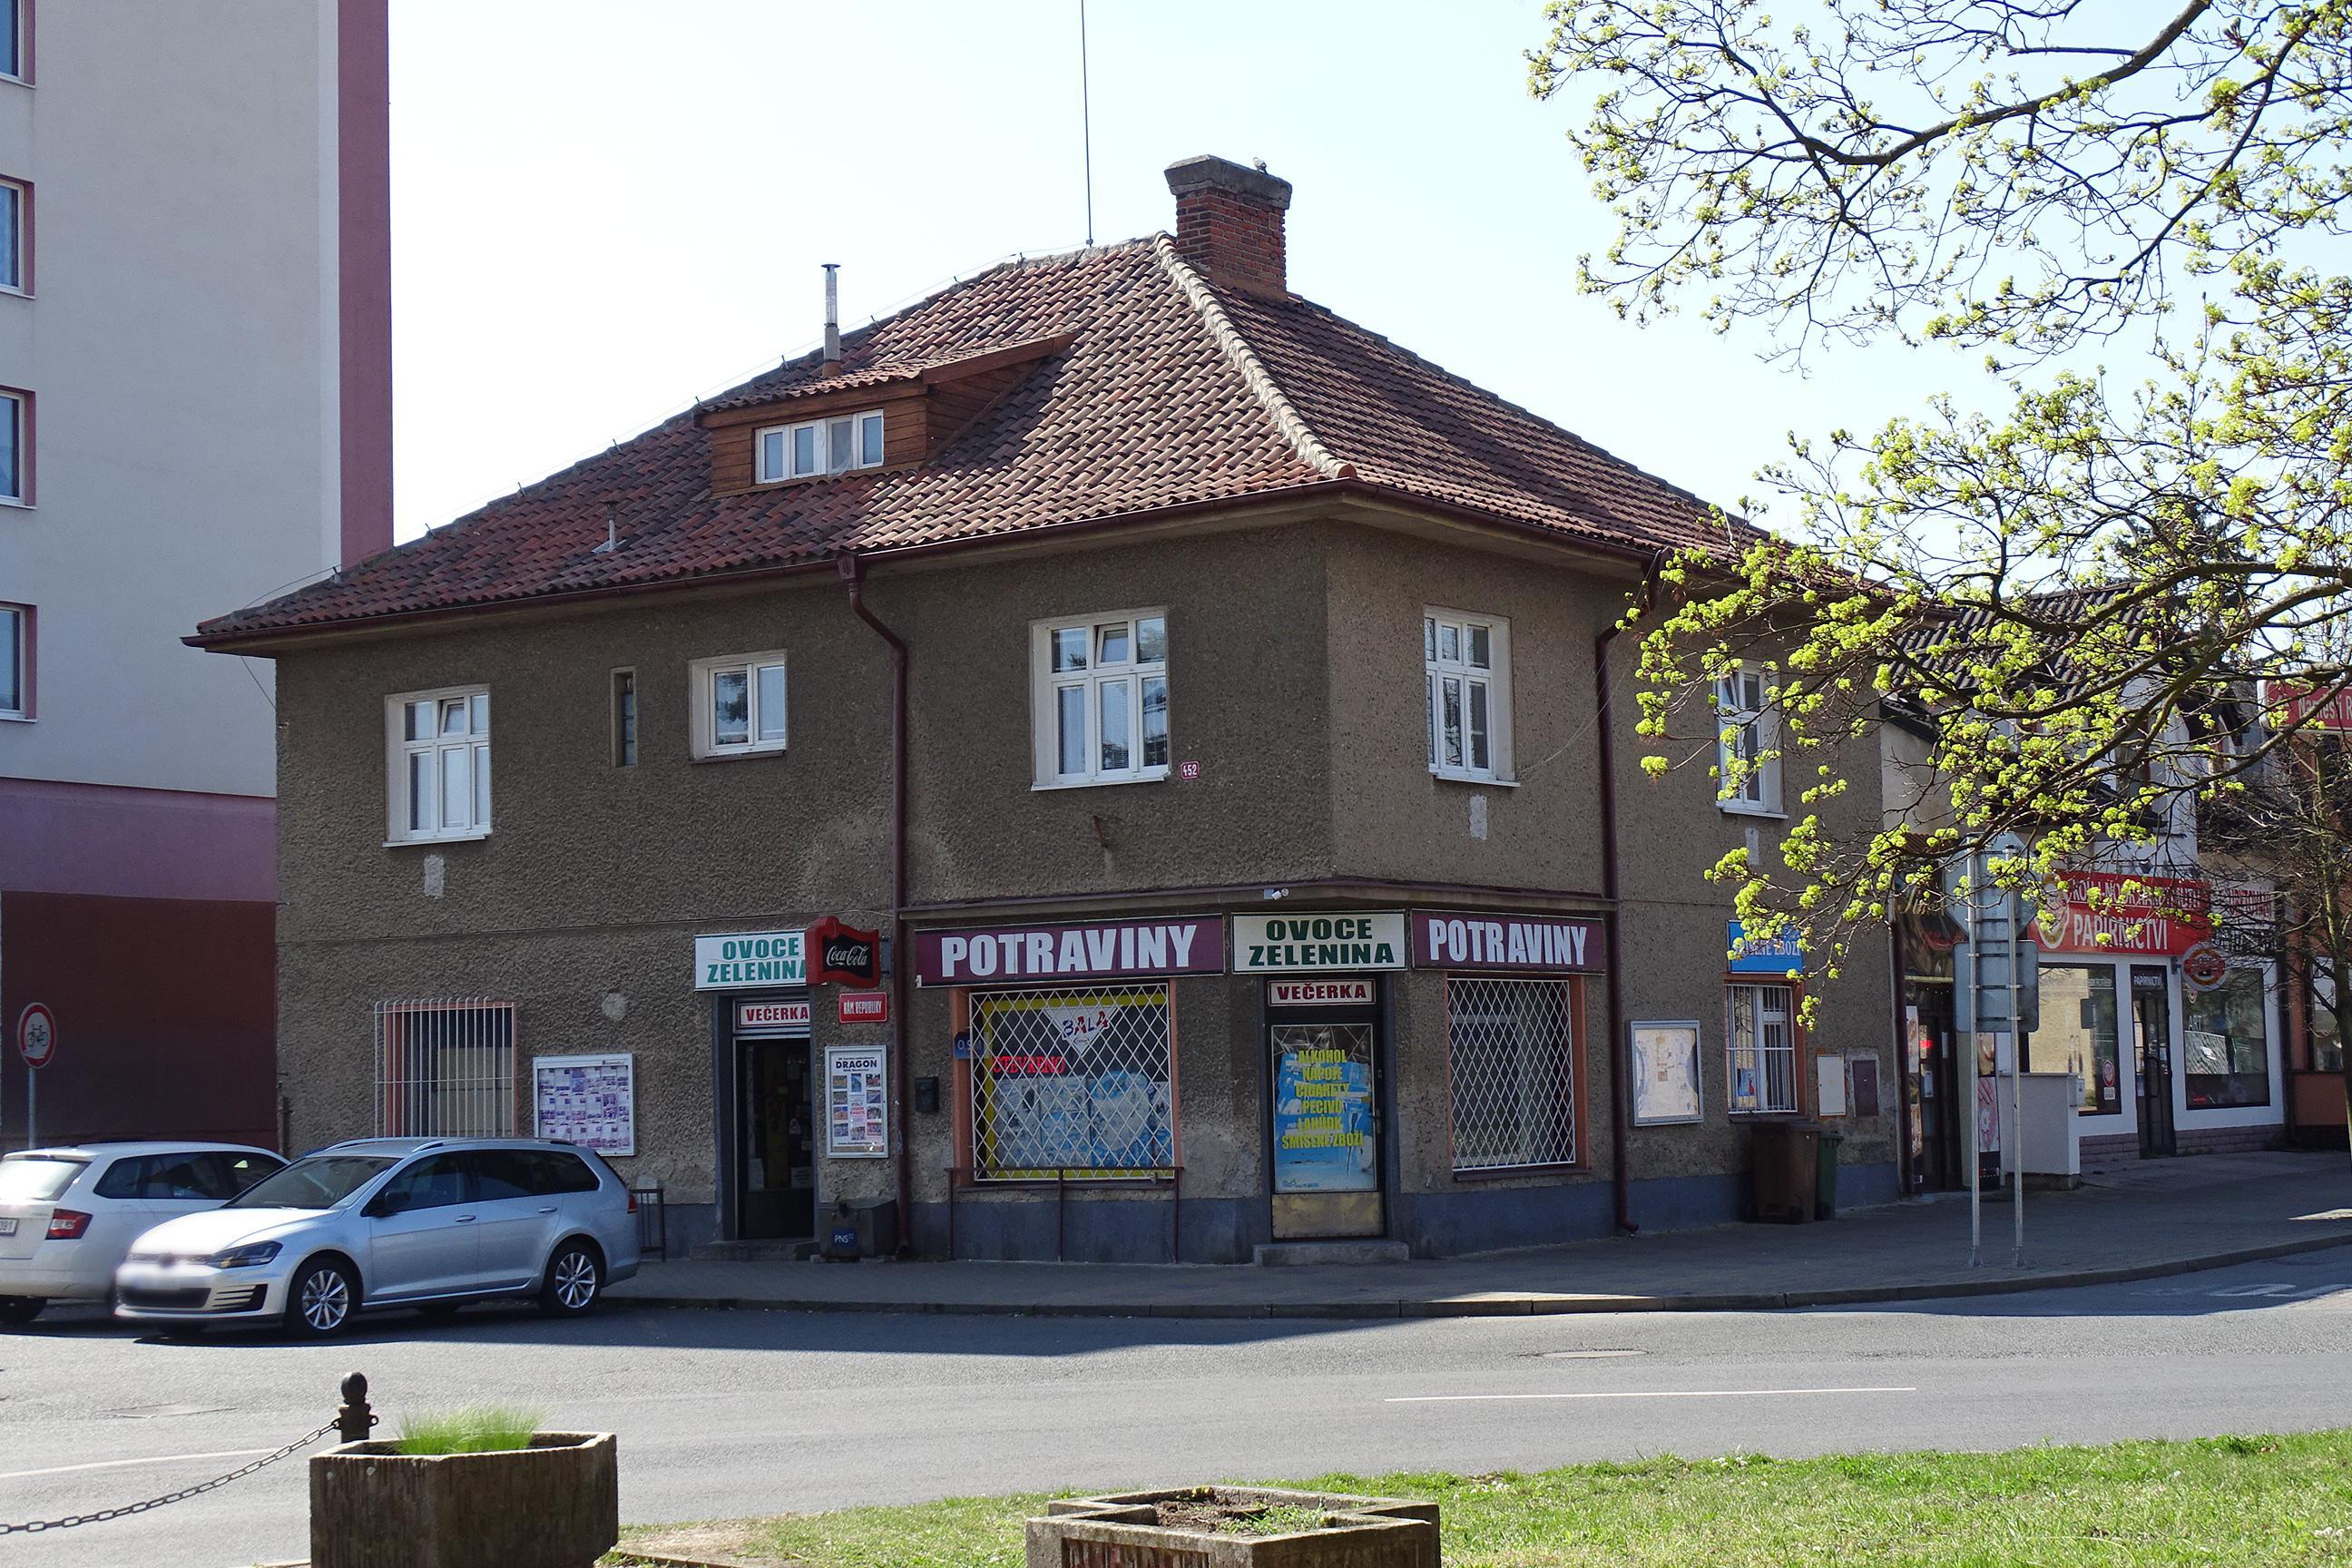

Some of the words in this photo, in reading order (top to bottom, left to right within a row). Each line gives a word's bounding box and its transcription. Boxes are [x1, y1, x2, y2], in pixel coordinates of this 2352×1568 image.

[1182, 763, 1197, 777] 452
[1266, 918, 1373, 941] OVOCE
[721, 937, 799, 960] OVOCE
[941, 925, 1197, 977] POTRAVINY
[1428, 918, 1588, 966] POTRAVINY
[1249, 943, 1395, 965] ZELENINA
[707, 961, 807, 984] ZELENINA
[1277, 982, 1367, 1000] VEČERKA
[746, 1005, 808, 1022] VEČERKA
[836, 1060, 877, 1069] DRAGON
[1298, 1050, 1347, 1063] ALKOHOL
